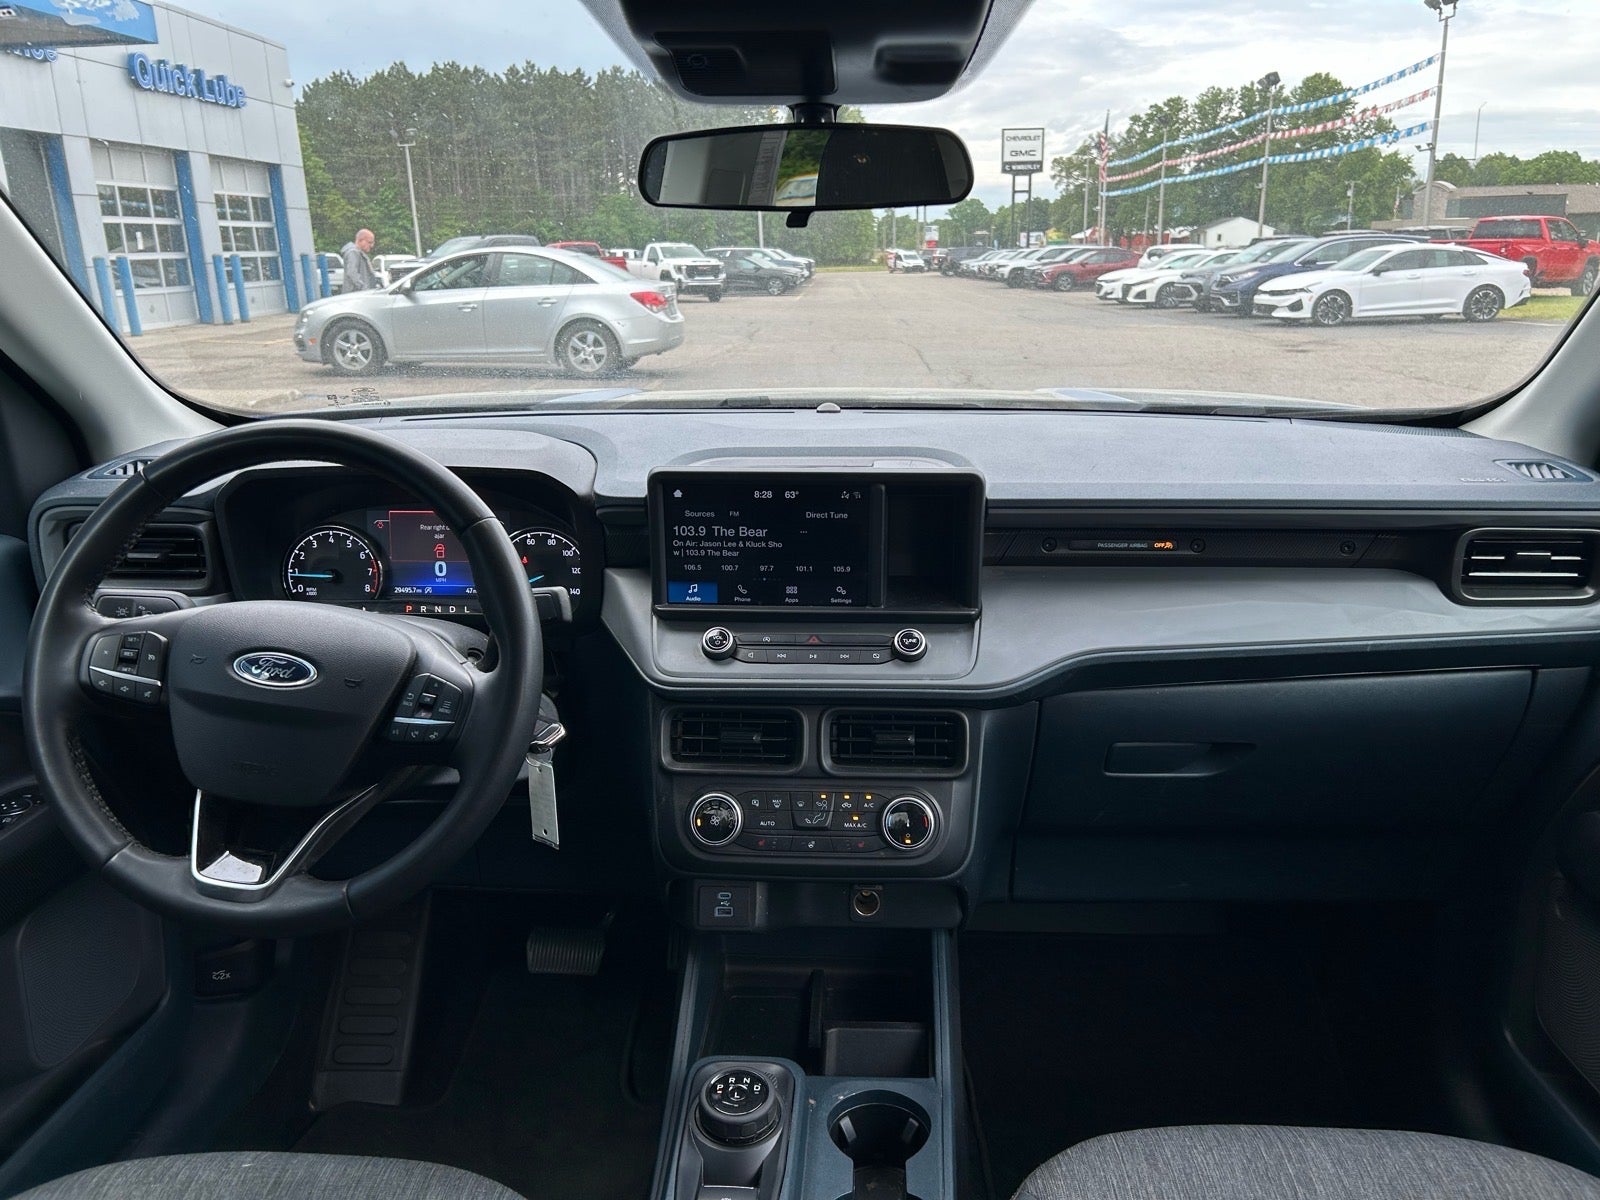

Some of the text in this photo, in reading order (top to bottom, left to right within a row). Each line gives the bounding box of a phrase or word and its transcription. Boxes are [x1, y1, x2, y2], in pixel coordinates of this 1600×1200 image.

[128, 50, 247, 109] Quick Lube
[754, 490, 772, 499] 8:28
[684, 510, 715, 518] Sources
[673, 526, 768, 537] 103.9 The Bear
[434, 561, 447, 577] 0
[252, 657, 296, 680] Ford
